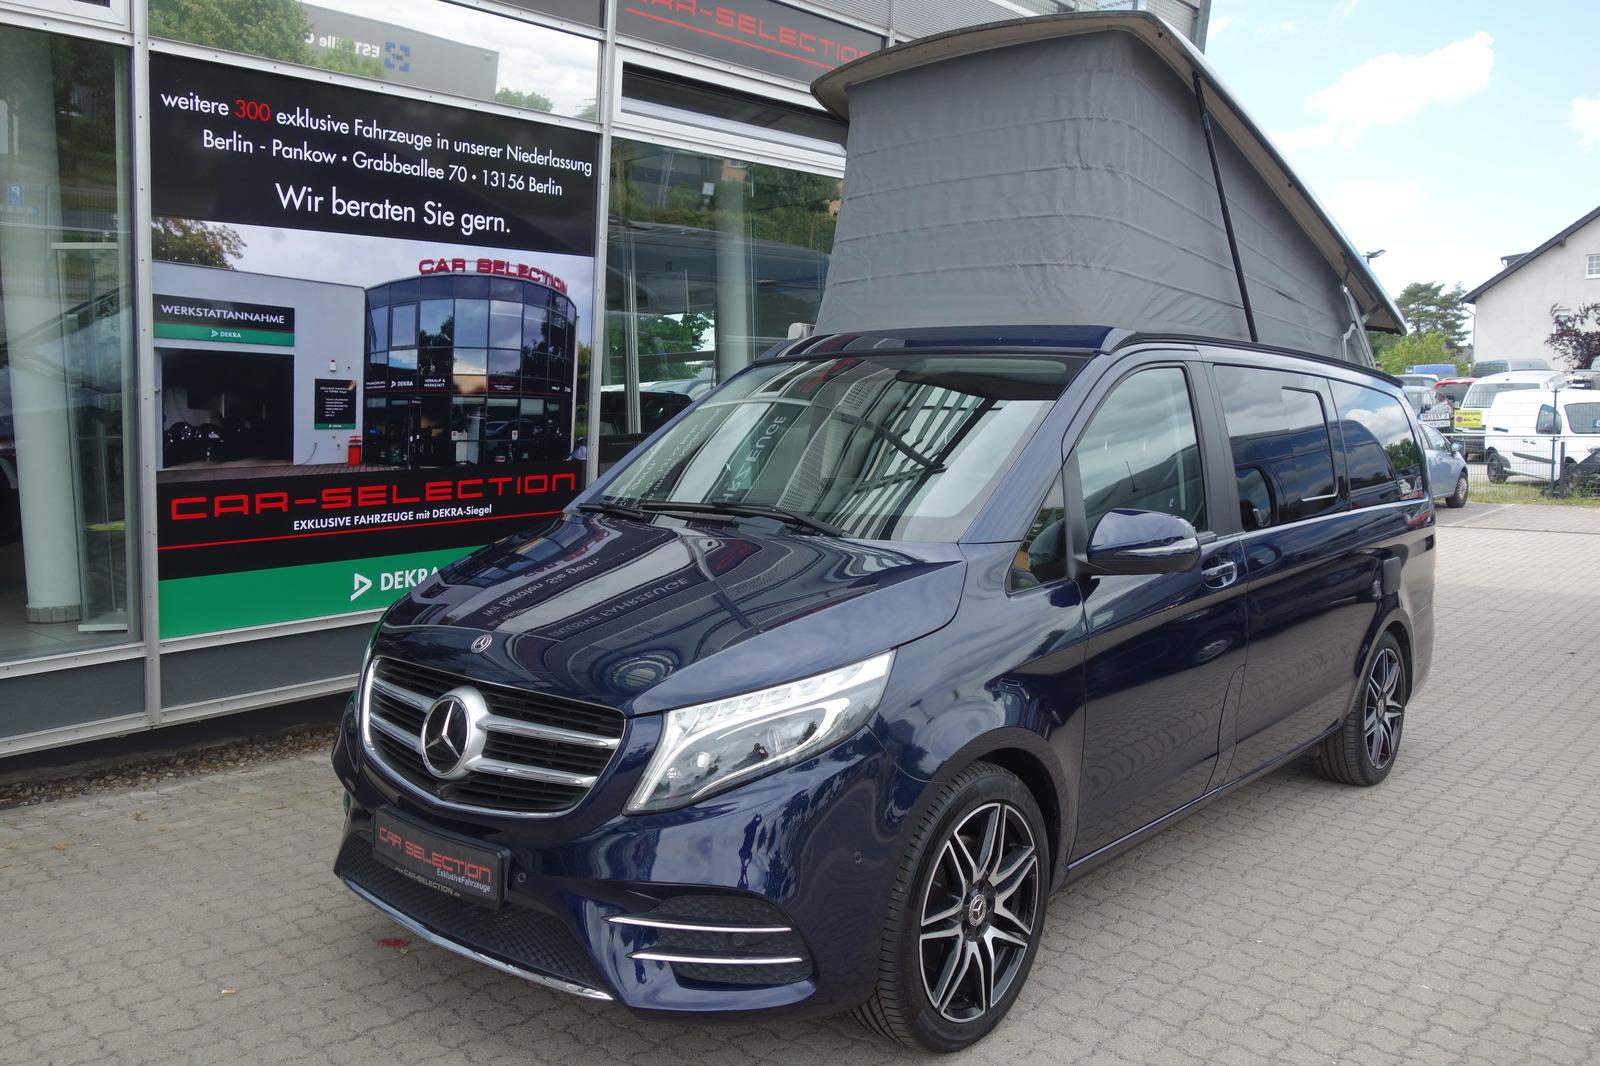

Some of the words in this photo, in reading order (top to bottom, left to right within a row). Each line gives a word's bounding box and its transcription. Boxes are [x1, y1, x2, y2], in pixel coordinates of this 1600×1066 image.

[161, 92, 229, 115] weitere
[234, 99, 271, 122] 300
[276, 107, 349, 134] exklusive
[355, 119, 432, 150] Fahrzeuge
[437, 133, 449, 150] in
[454, 141, 503, 159] unserer
[506, 144, 592, 176] Niederlassung
[203, 129, 253, 153] Berlin
[272, 139, 336, 164] Pankow
[353, 151, 444, 179] Grabbeallee
[449, 165, 467, 183] 70
[482, 170, 525, 191] 13156
[529, 177, 563, 195] Berlin
[275, 183, 324, 212] Wir
[332, 186, 416, 223] beraten
[423, 200, 454, 227] Sie
[461, 212, 511, 236] gern.
[419, 258, 466, 275] CAR
[477, 258, 567, 293] SELECTION
[160, 303, 285, 324] WERKSTATTANNAHME
[171, 473, 576, 521] CAR-SELECTION
[293, 516, 351, 531] EXKLUSIVE
[354, 511, 414, 525] FAHRZEUGE
[416, 510, 430, 520] mit
[432, 504, 492, 518] DEKRA-Siegel
[379, 826, 402, 849] CAR
[405, 840, 491, 882] SELECTION
